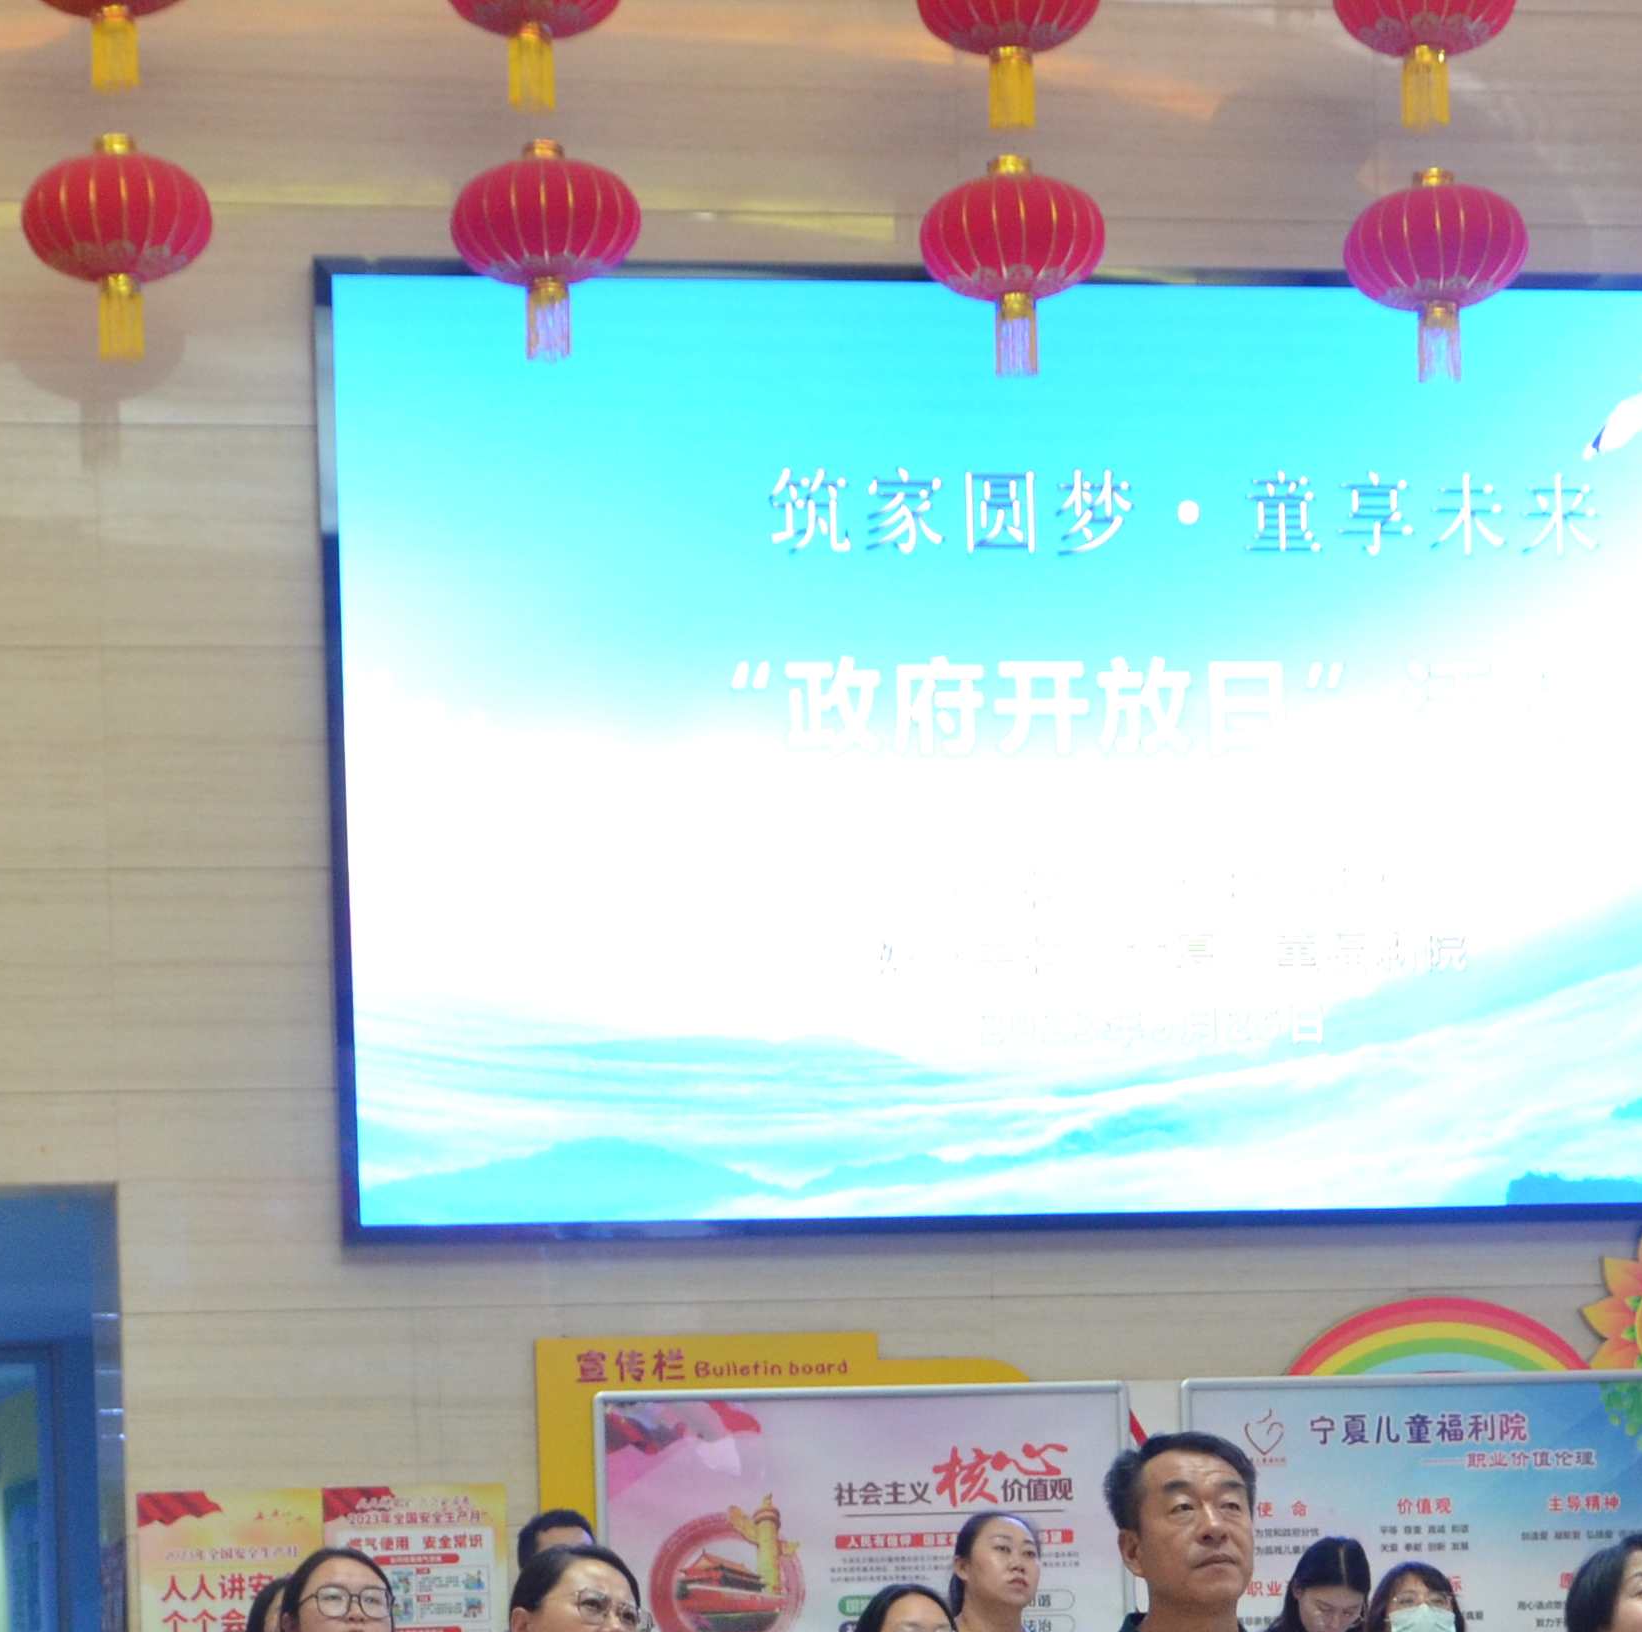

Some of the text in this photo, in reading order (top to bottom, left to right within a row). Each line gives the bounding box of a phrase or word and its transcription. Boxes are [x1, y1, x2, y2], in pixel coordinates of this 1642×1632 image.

[576, 1347, 686, 1383] 宣传栏
[694, 1359, 849, 1378] Bulletin board
[1309, 1412, 1528, 1446] 宁夏儿童福利院
[1397, 1497, 1452, 1515] 价值观
[1548, 1494, 1621, 1513] 主导精神
[422, 1533, 484, 1550] 安全常识
